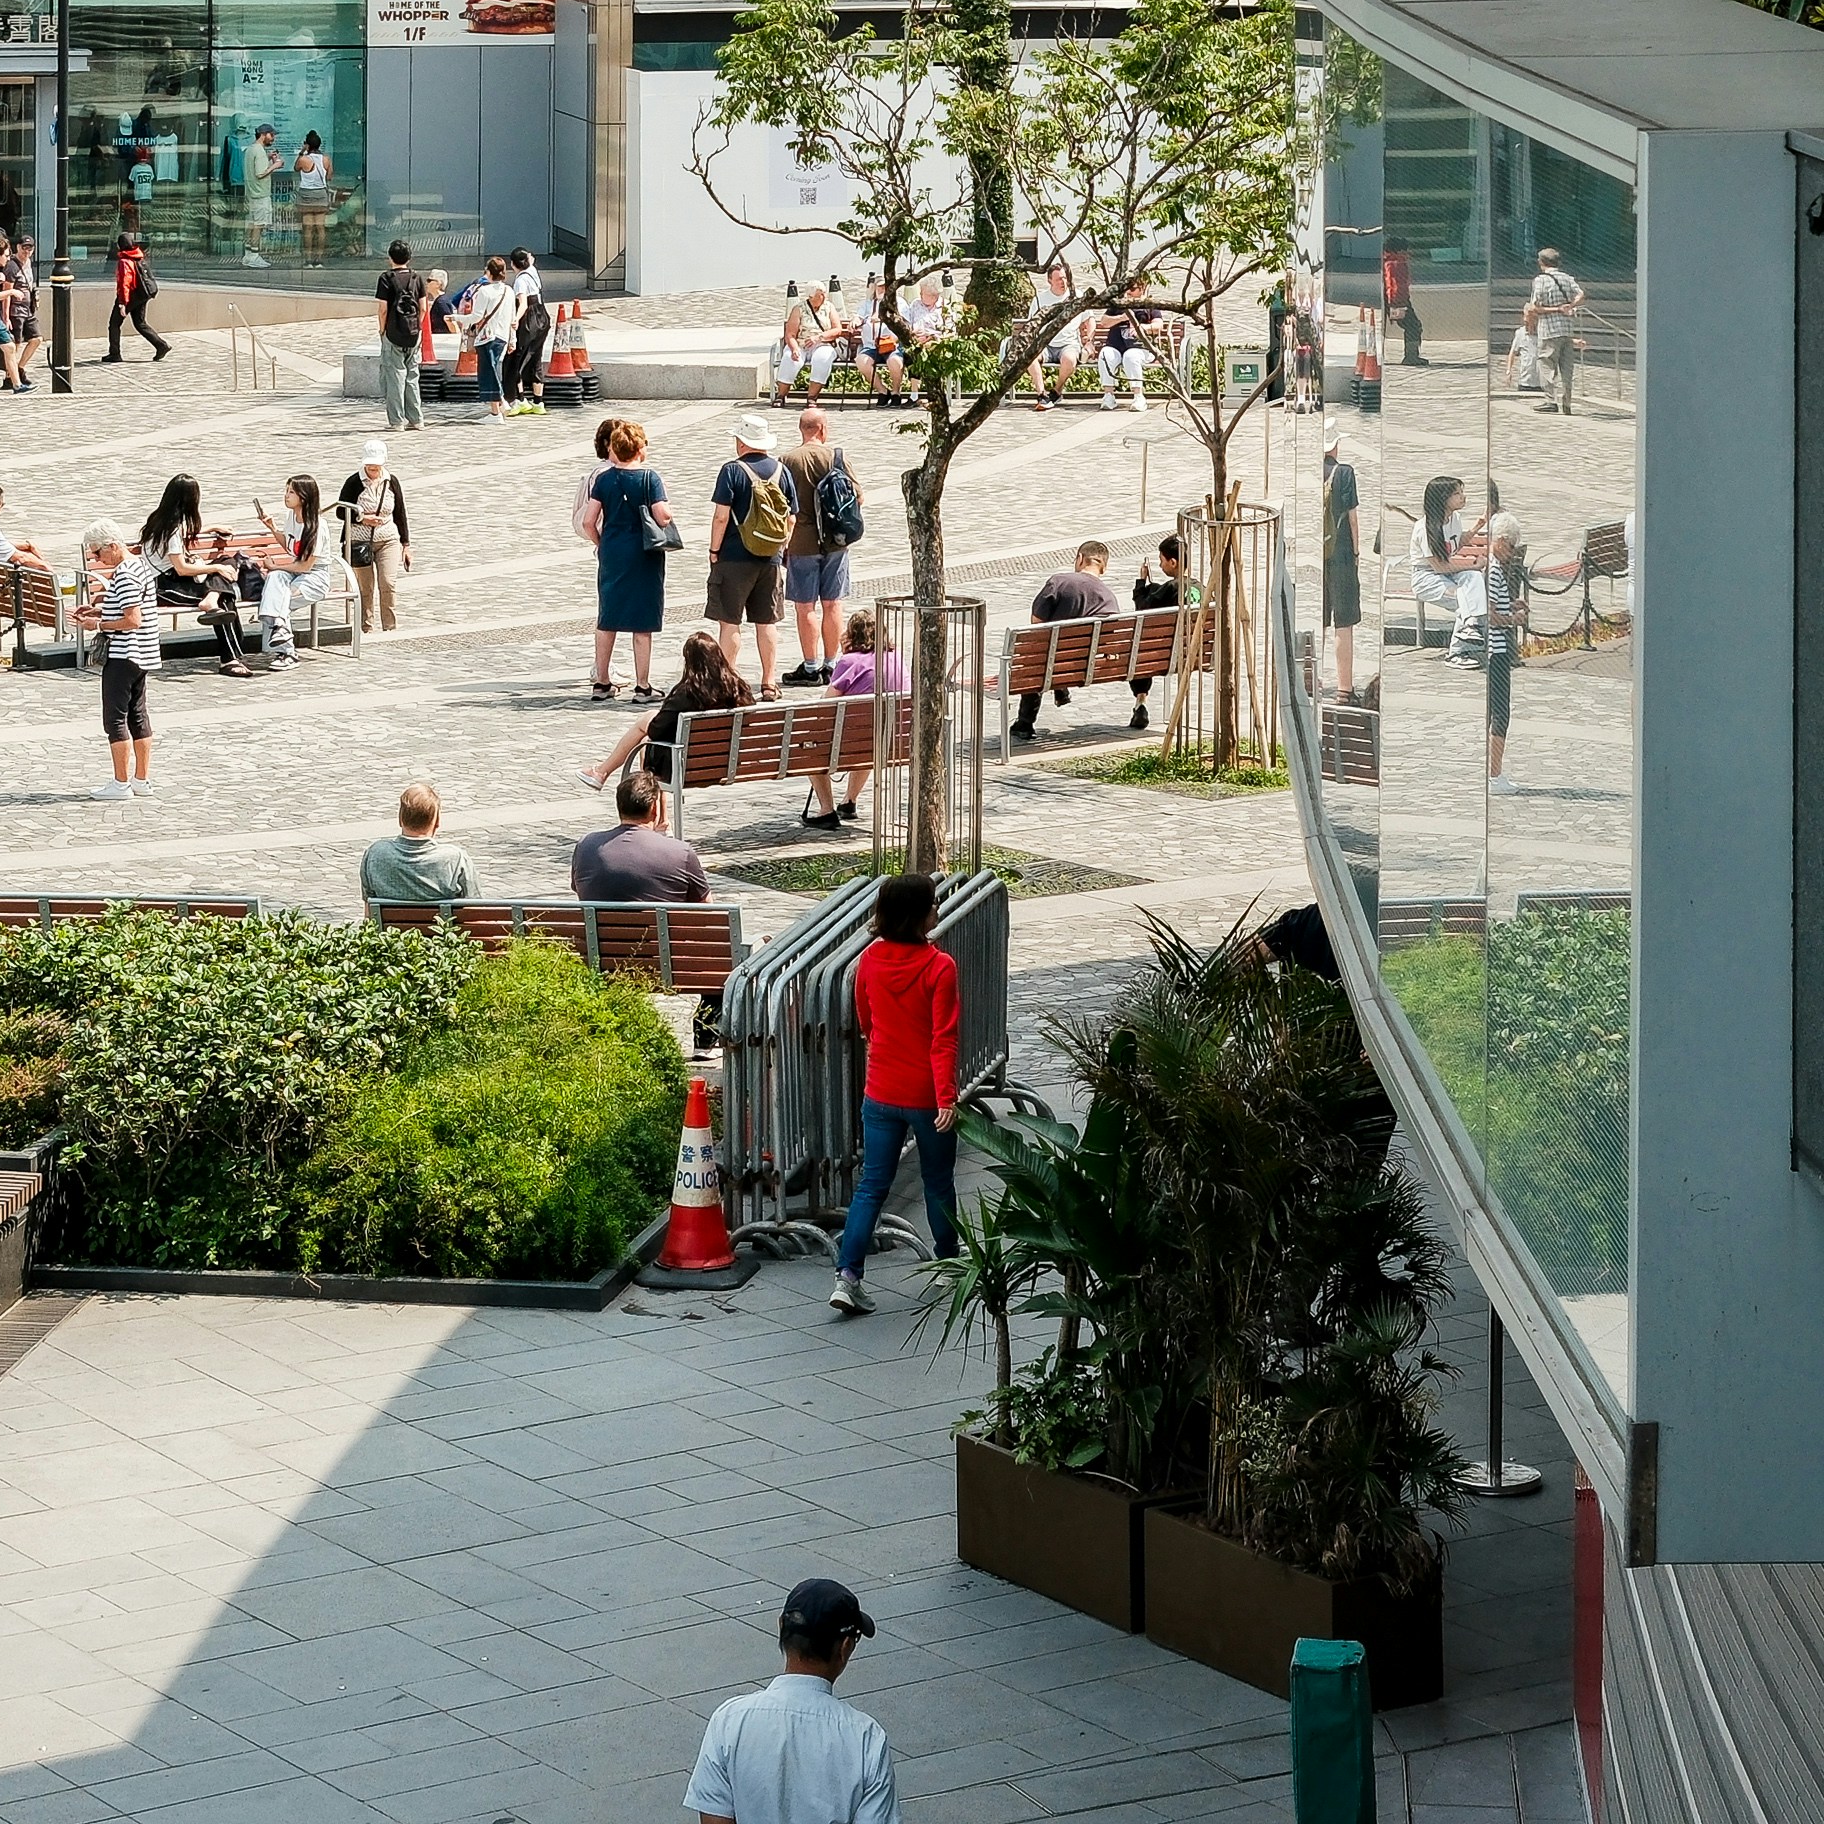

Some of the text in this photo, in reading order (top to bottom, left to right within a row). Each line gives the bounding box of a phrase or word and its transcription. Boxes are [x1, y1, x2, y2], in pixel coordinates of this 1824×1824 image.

[414, 1, 425, 10] OF
[426, 1, 441, 10] THE
[377, 10, 450, 22] WHOPPER
[403, 27, 427, 42] 1/F
[242, 73, 265, 84] A-Z
[112, 137, 157, 146] HOMEKON
[681, 1144, 714, 1163] 警察
